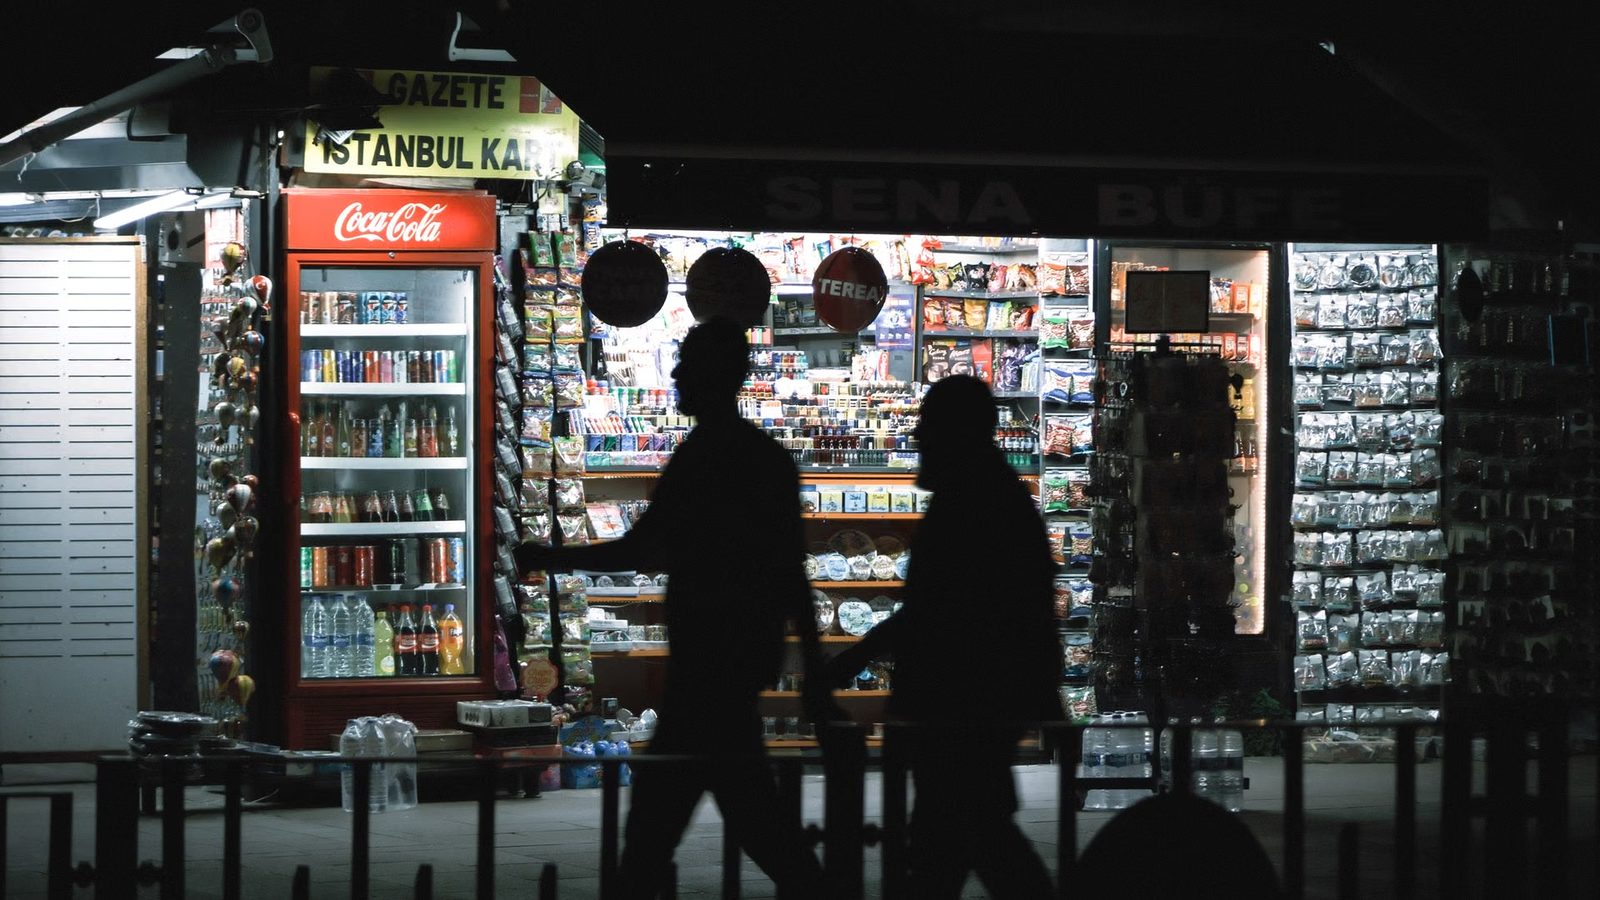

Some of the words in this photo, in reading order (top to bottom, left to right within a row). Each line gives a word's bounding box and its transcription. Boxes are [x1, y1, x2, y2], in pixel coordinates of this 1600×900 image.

[390, 73, 504, 109] GAZETE
[766, 176, 1031, 224] SENA
[334, 202, 448, 241] Coca-Cola
[818, 278, 879, 302] TEREA
